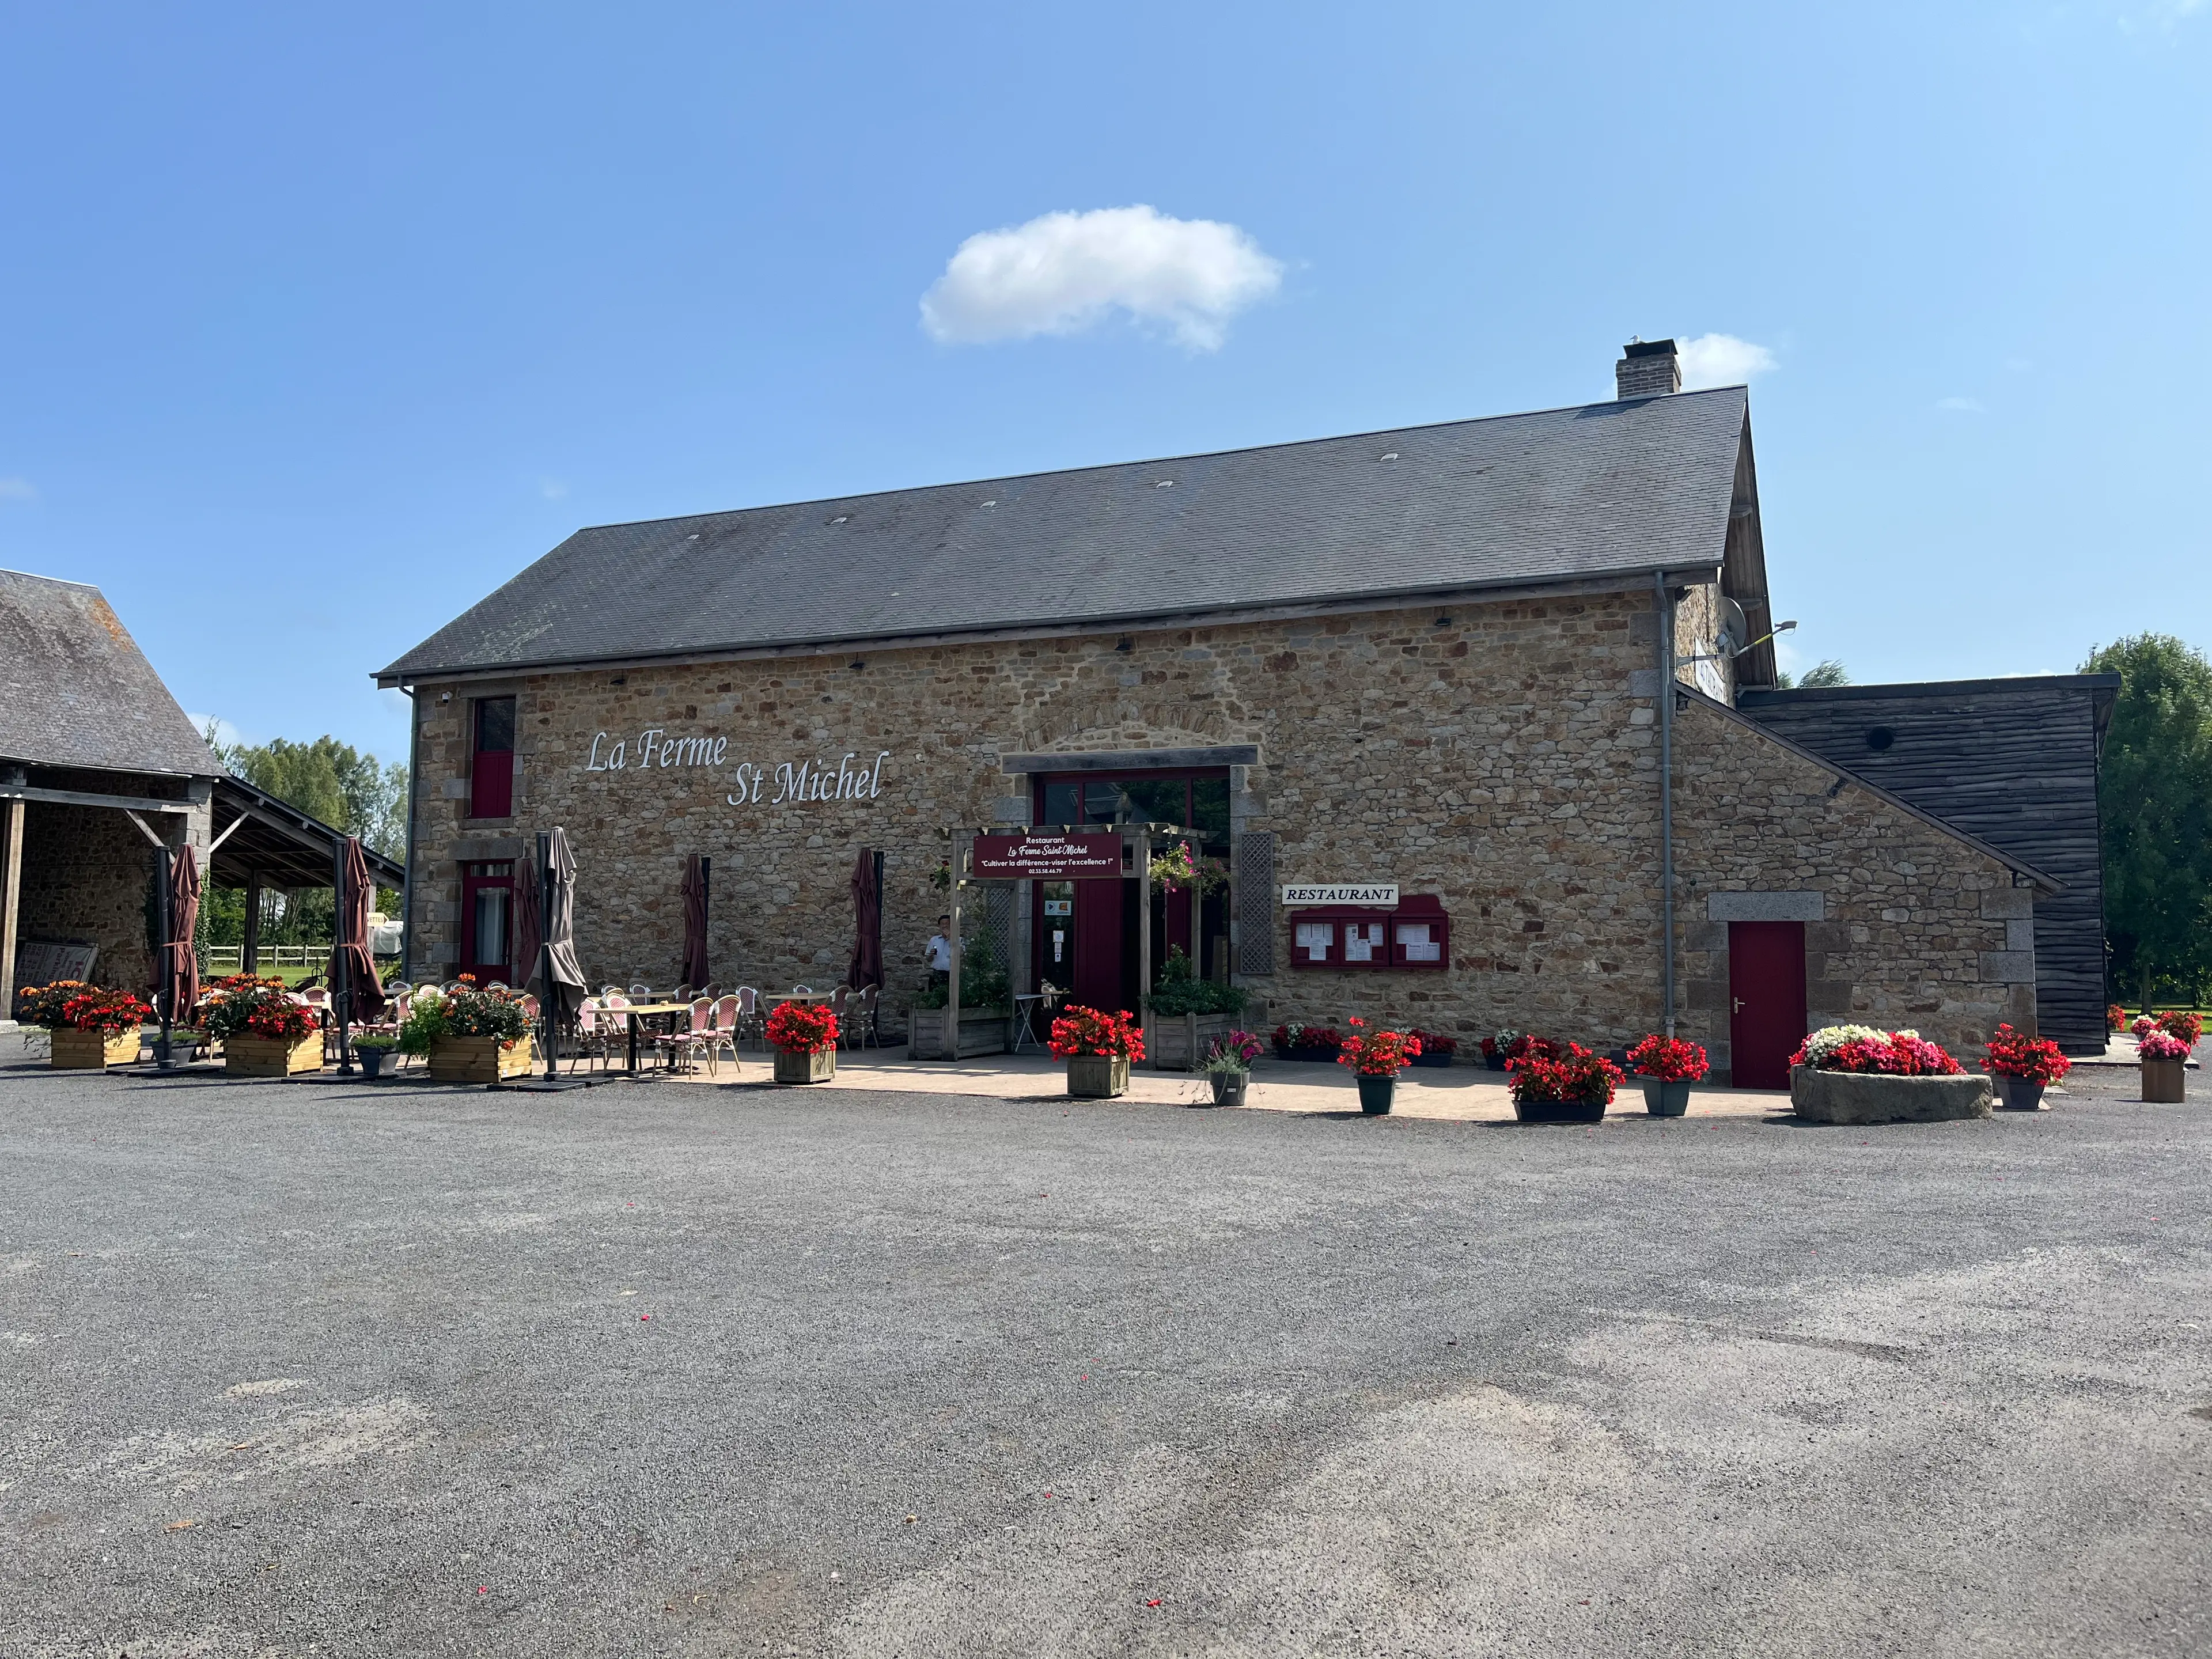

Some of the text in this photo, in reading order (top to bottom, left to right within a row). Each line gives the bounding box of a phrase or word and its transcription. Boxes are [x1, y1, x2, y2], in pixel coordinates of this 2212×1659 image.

[585, 729, 727, 771] La Ferme
[727, 751, 890, 806] St Michel
[1007, 844, 1088, 857] La Ferme Saint-Michel
[1286, 889, 1394, 900] RESTAURANT
[48, 948, 66, 979] Parking
